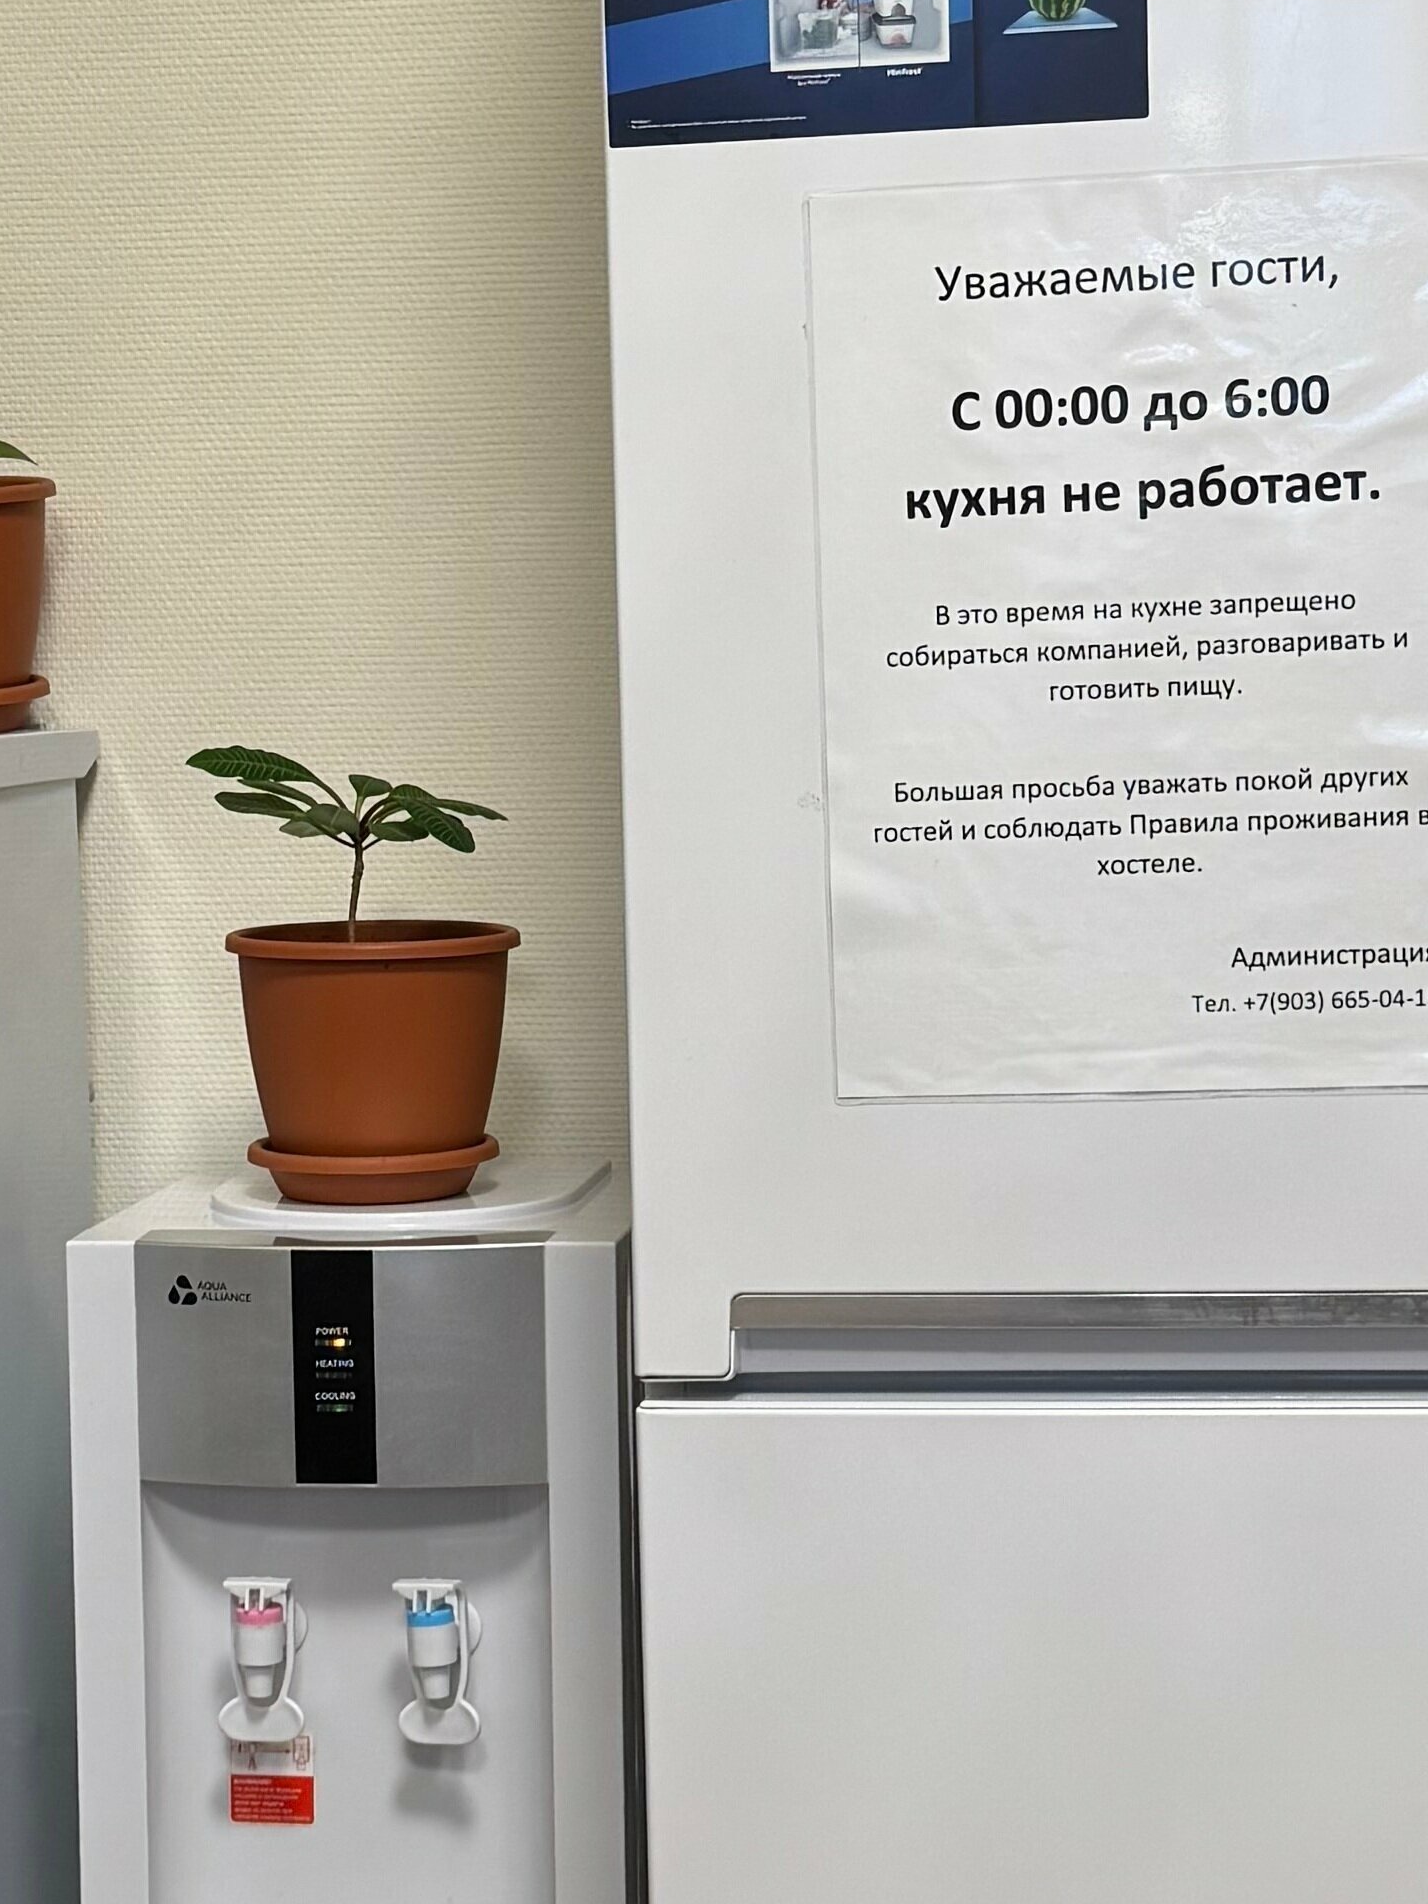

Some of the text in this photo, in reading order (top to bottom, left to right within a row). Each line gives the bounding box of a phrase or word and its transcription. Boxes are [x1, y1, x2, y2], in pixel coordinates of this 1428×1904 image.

[934, 255, 1338, 302] Уважаемые гости,
[995, 384, 1129, 430] 00:00
[1143, 390, 1208, 432] до
[1224, 374, 1330, 419] 6:00
[906, 463, 1380, 529] кухня не работает.
[935, 593, 1356, 628] В это время на кухне запрещено
[886, 631, 1408, 671] собираться компанией, разговаривать и
[1049, 678, 1243, 702] готовить пищу.
[894, 767, 1409, 804] Большая просьба уважать покой других
[873, 819, 953, 844] гостей
[961, 823, 976, 841] и
[984, 816, 1122, 842] соблюдать
[1130, 813, 1239, 840] Правила
[1247, 809, 1409, 836] проживания
[1096, 856, 1203, 876] хостеле.
[1191, 994, 1237, 1014] Тел.
[1243, 989, 1324, 1016] +7(903)
[197, 1280, 228, 1291] AQUA
[201, 1292, 252, 1304] ALLIANCE
[315, 1326, 349, 1336] POWER
[315, 1359, 355, 1369] HEATING
[314, 1391, 356, 1401] COOLING
